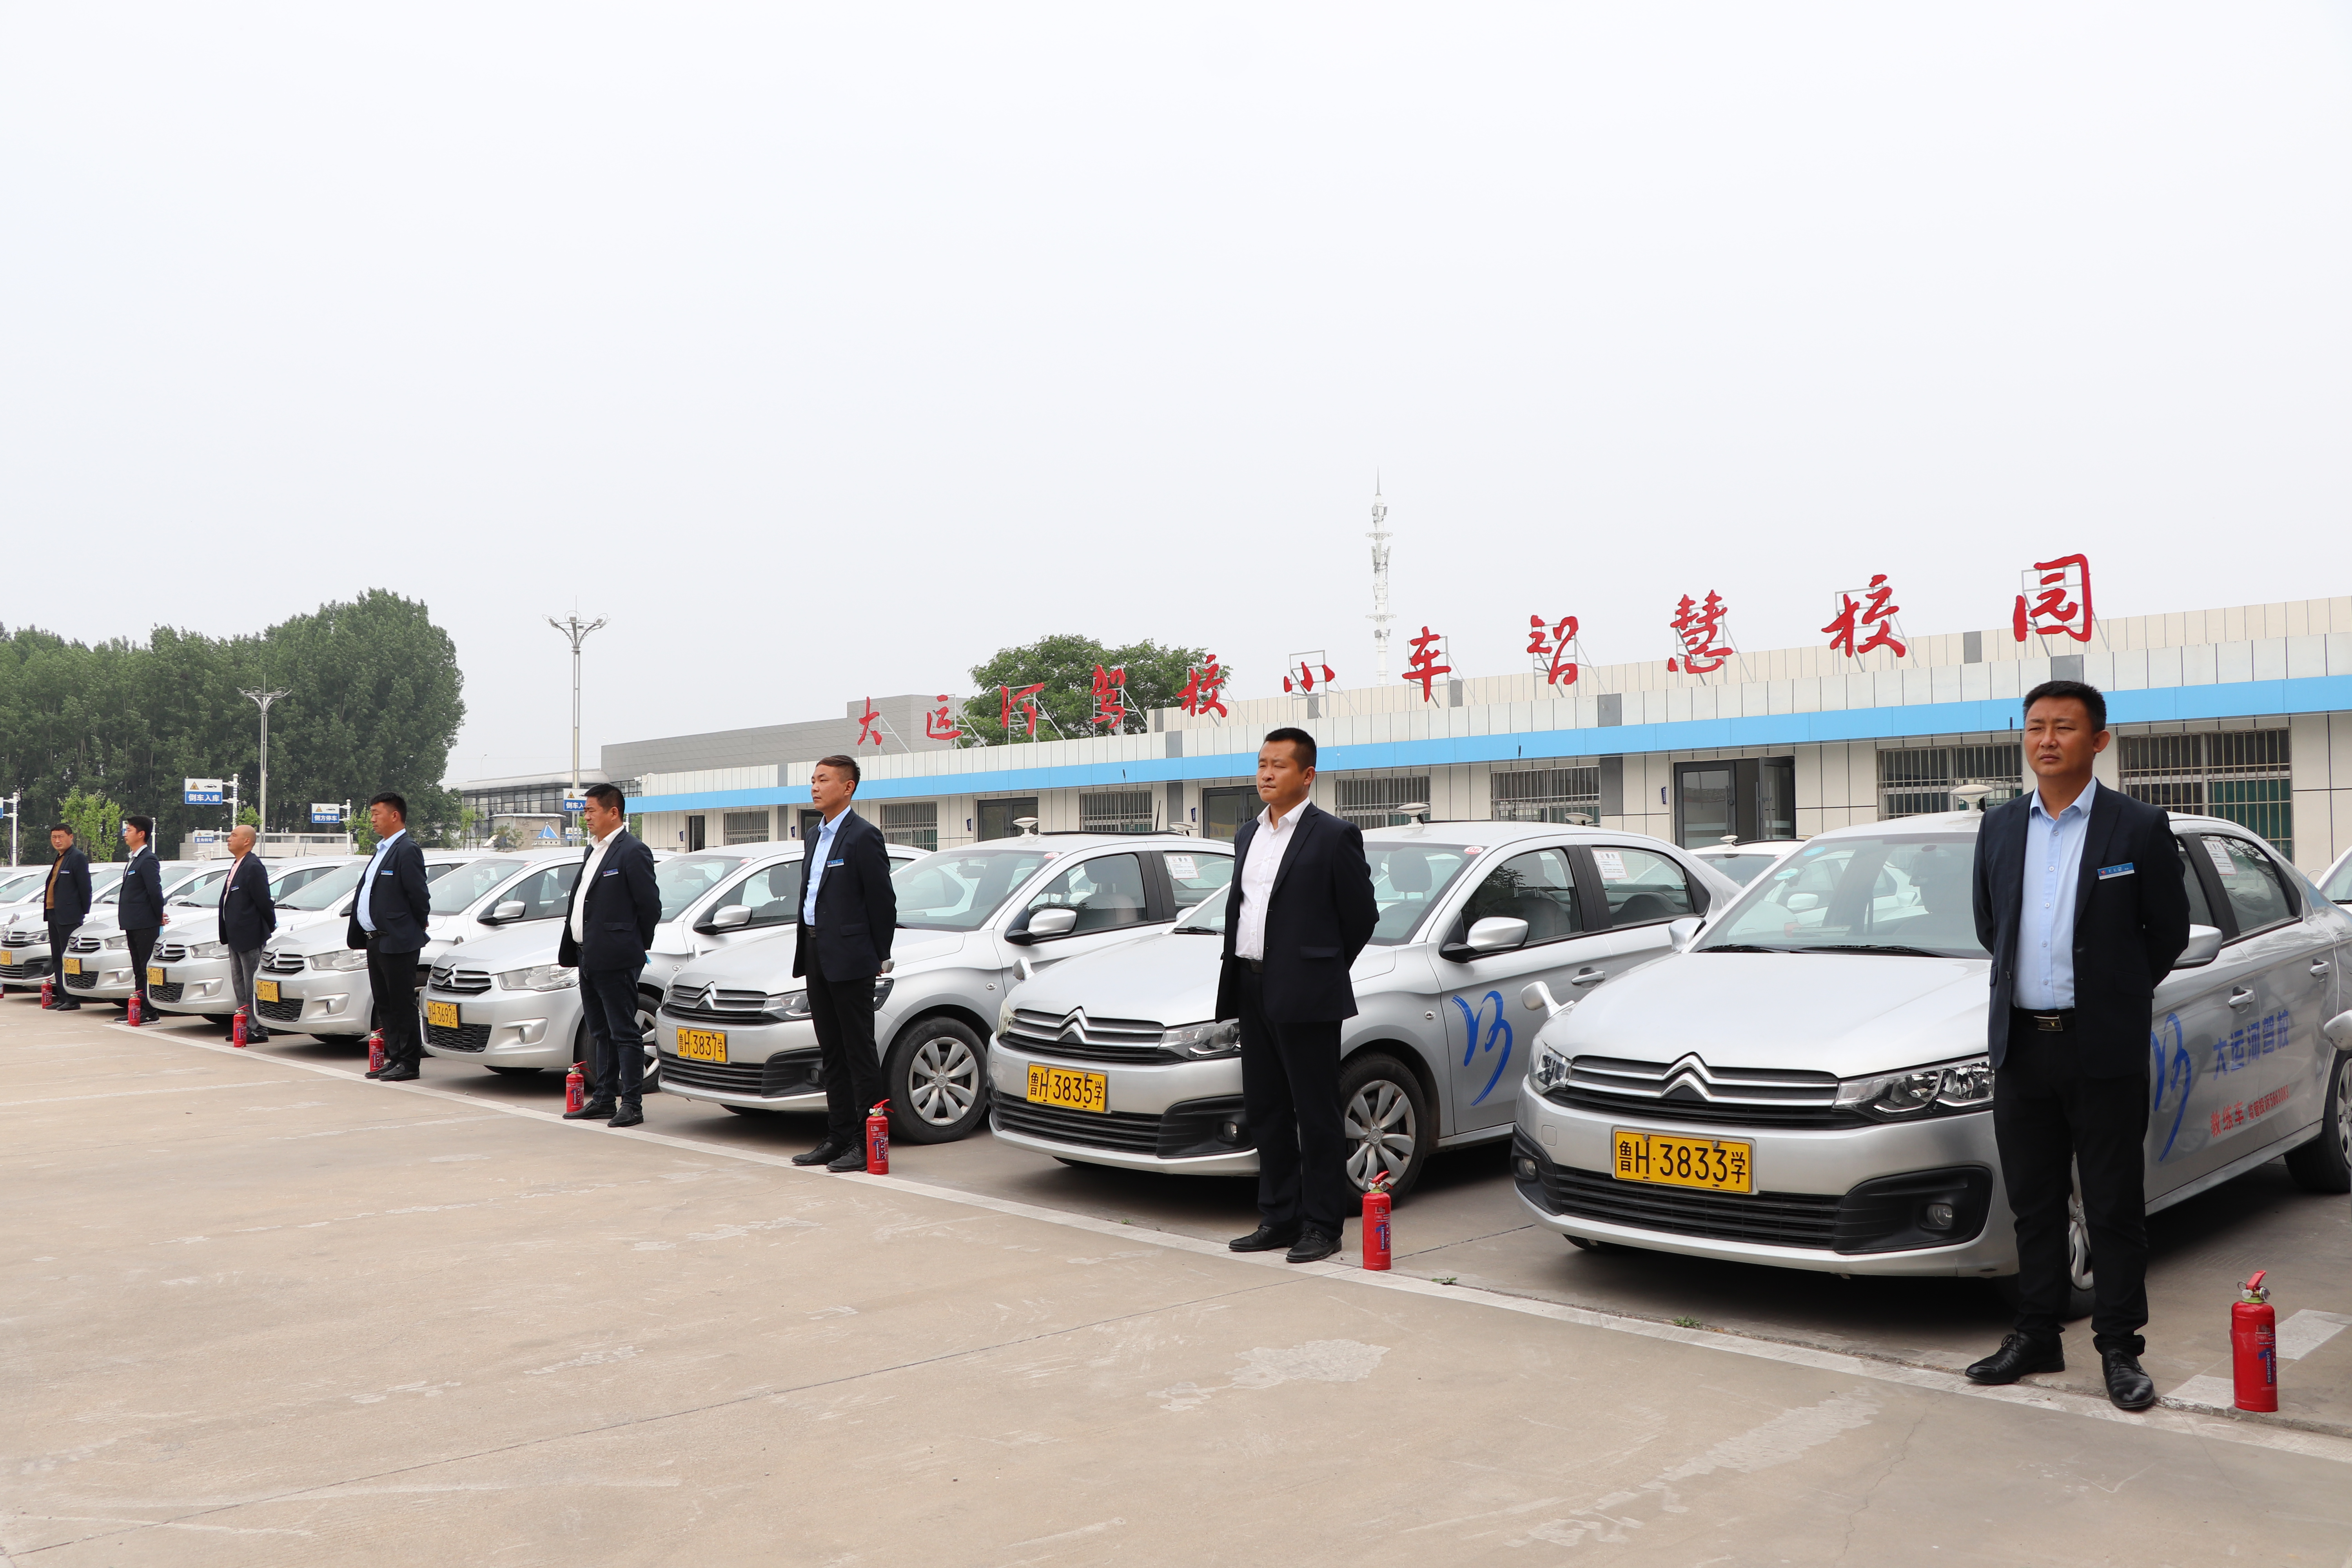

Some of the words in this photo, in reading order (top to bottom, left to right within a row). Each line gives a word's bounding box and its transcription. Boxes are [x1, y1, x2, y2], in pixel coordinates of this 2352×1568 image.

[188, 793, 220, 802] 倒车入库
[2210, 1100, 2244, 1138] 教练车
